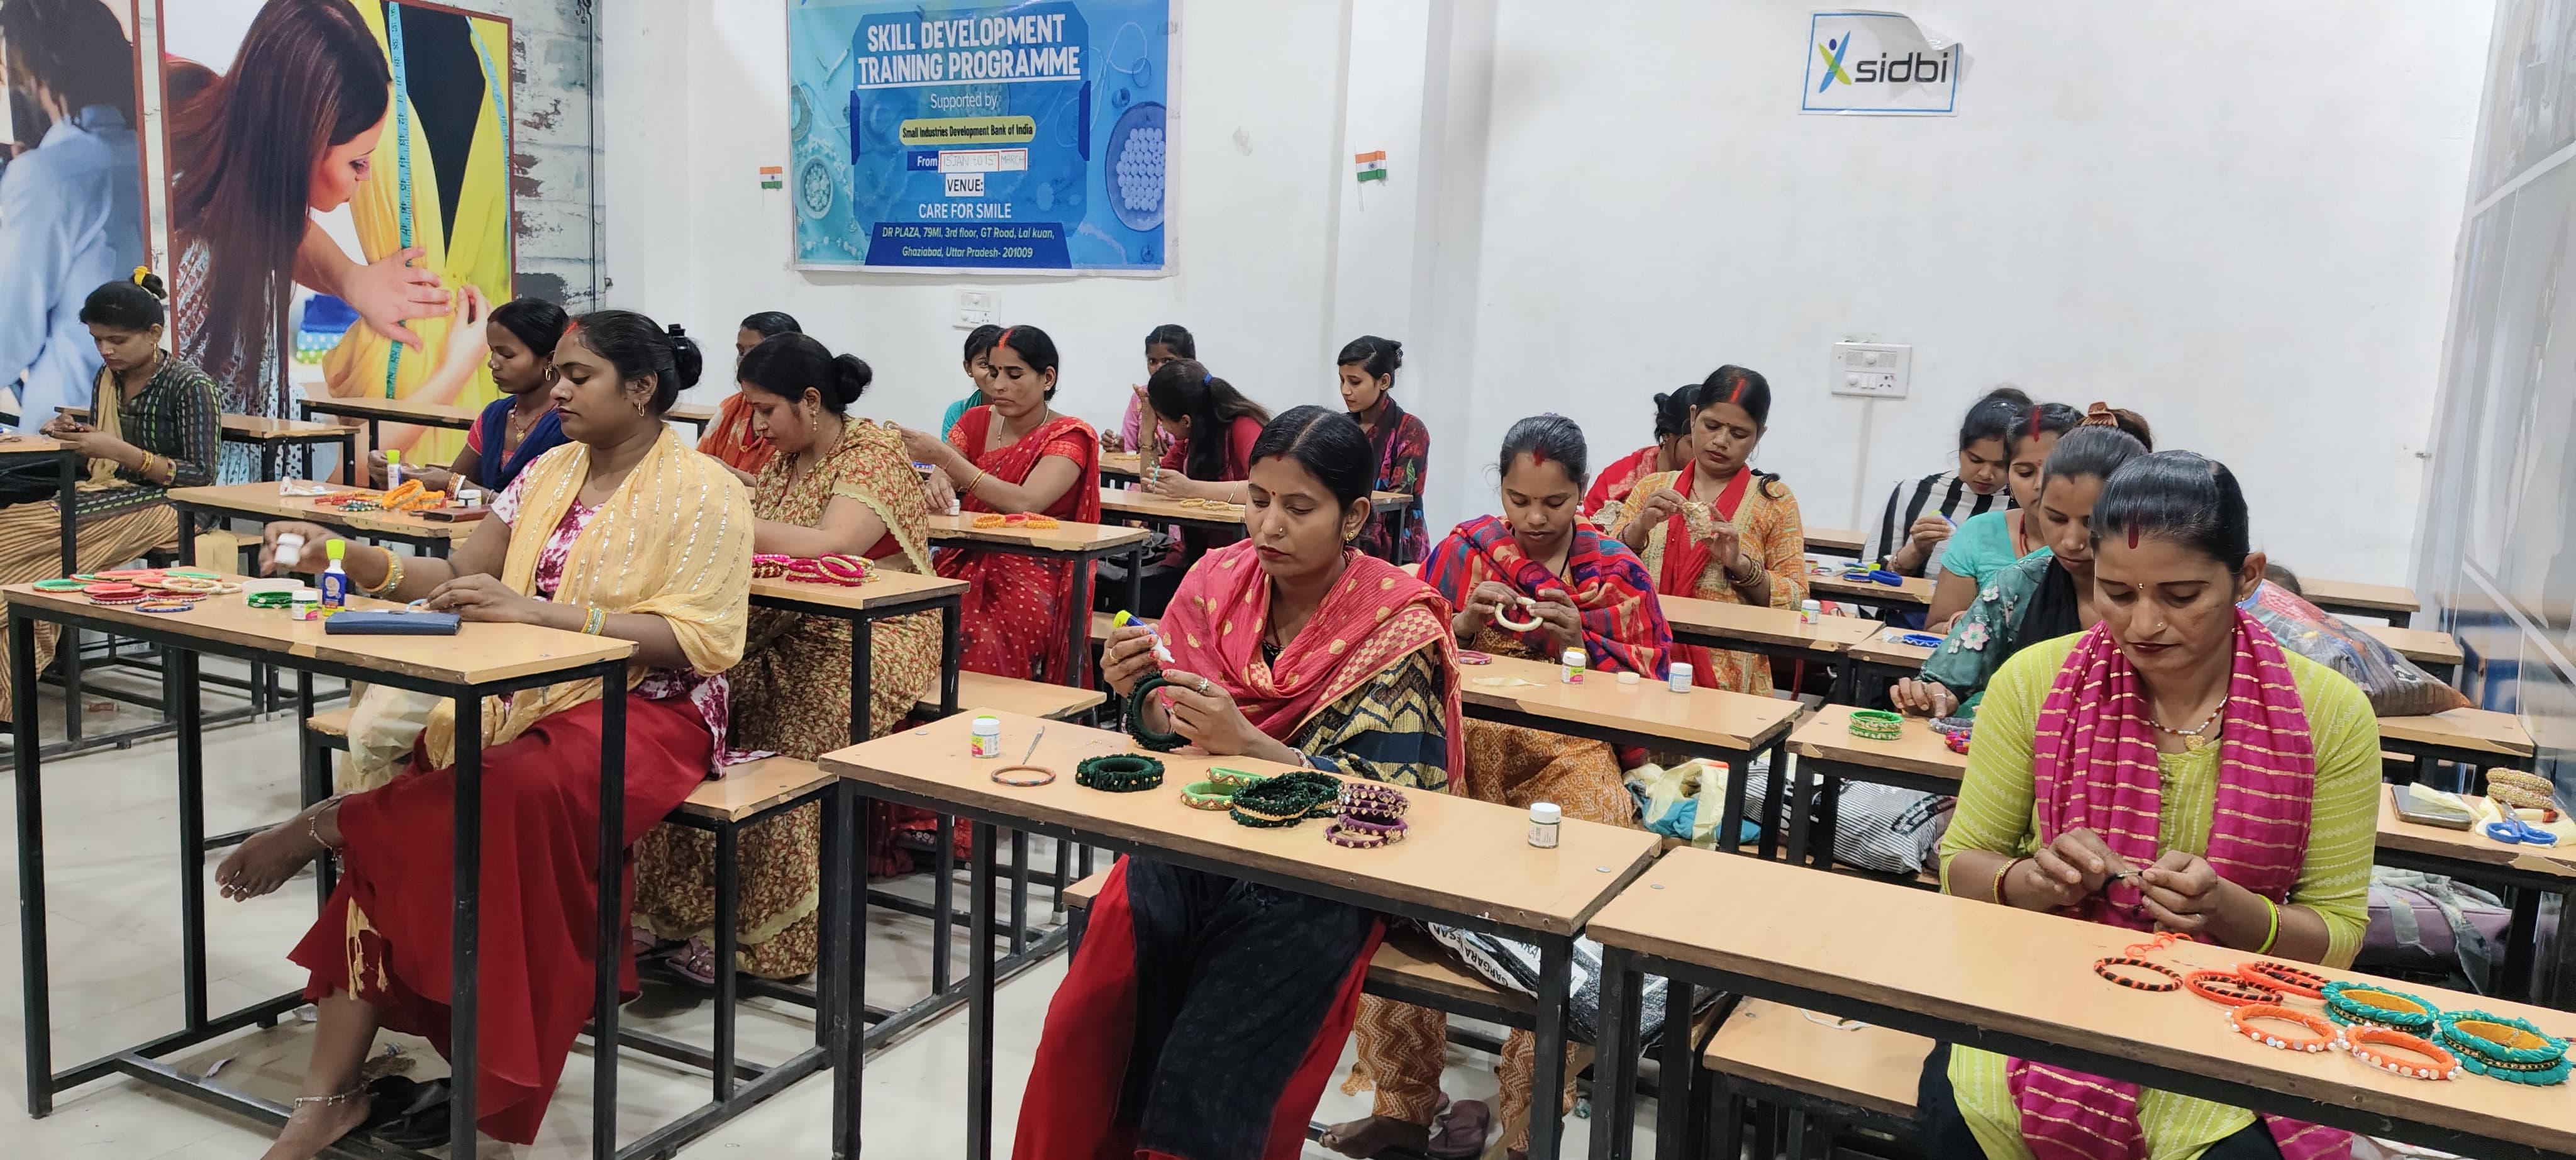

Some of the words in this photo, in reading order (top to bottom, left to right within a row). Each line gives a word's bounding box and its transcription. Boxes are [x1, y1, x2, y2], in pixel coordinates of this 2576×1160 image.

[867, 23, 916, 52] SKILL
[921, 14, 1065, 50] DEVELOPMENT
[858, 53, 943, 84] TRAINING
[948, 46, 1080, 80] PROGRAMME
[1855, 52, 1948, 82] sidbi
[931, 93, 982, 111] Supported
[984, 92, 997, 109] by
[902, 128, 918, 138] Small
[919, 126, 948, 137] Industries
[950, 125, 989, 138] Development
[991, 125, 1006, 135] Bank
[1008, 124, 1014, 135] of
[1016, 123, 1033, 135] India
[917, 156, 937, 167] From
[947, 179, 983, 192] VENUE:
[919, 203, 948, 218] CARE
[951, 203, 974, 218] FOR
[976, 203, 1012, 218] SMILE
[882, 226, 893, 237] DR
[894, 227, 921, 238] PLAZA,
[945, 227, 957, 237] 3rd
[959, 227, 978, 239] floor,
[980, 227, 992, 237] GT
[994, 227, 1016, 239] Road,
[1019, 227, 1031, 238] Lal
[1032, 227, 1054, 239] kuan,
[902, 246, 943, 258] Ghaziabad,
[945, 247, 965, 257] Uttar
[967, 247, 1001, 257] Pradesh-
[1002, 247, 1033, 258] 201009
